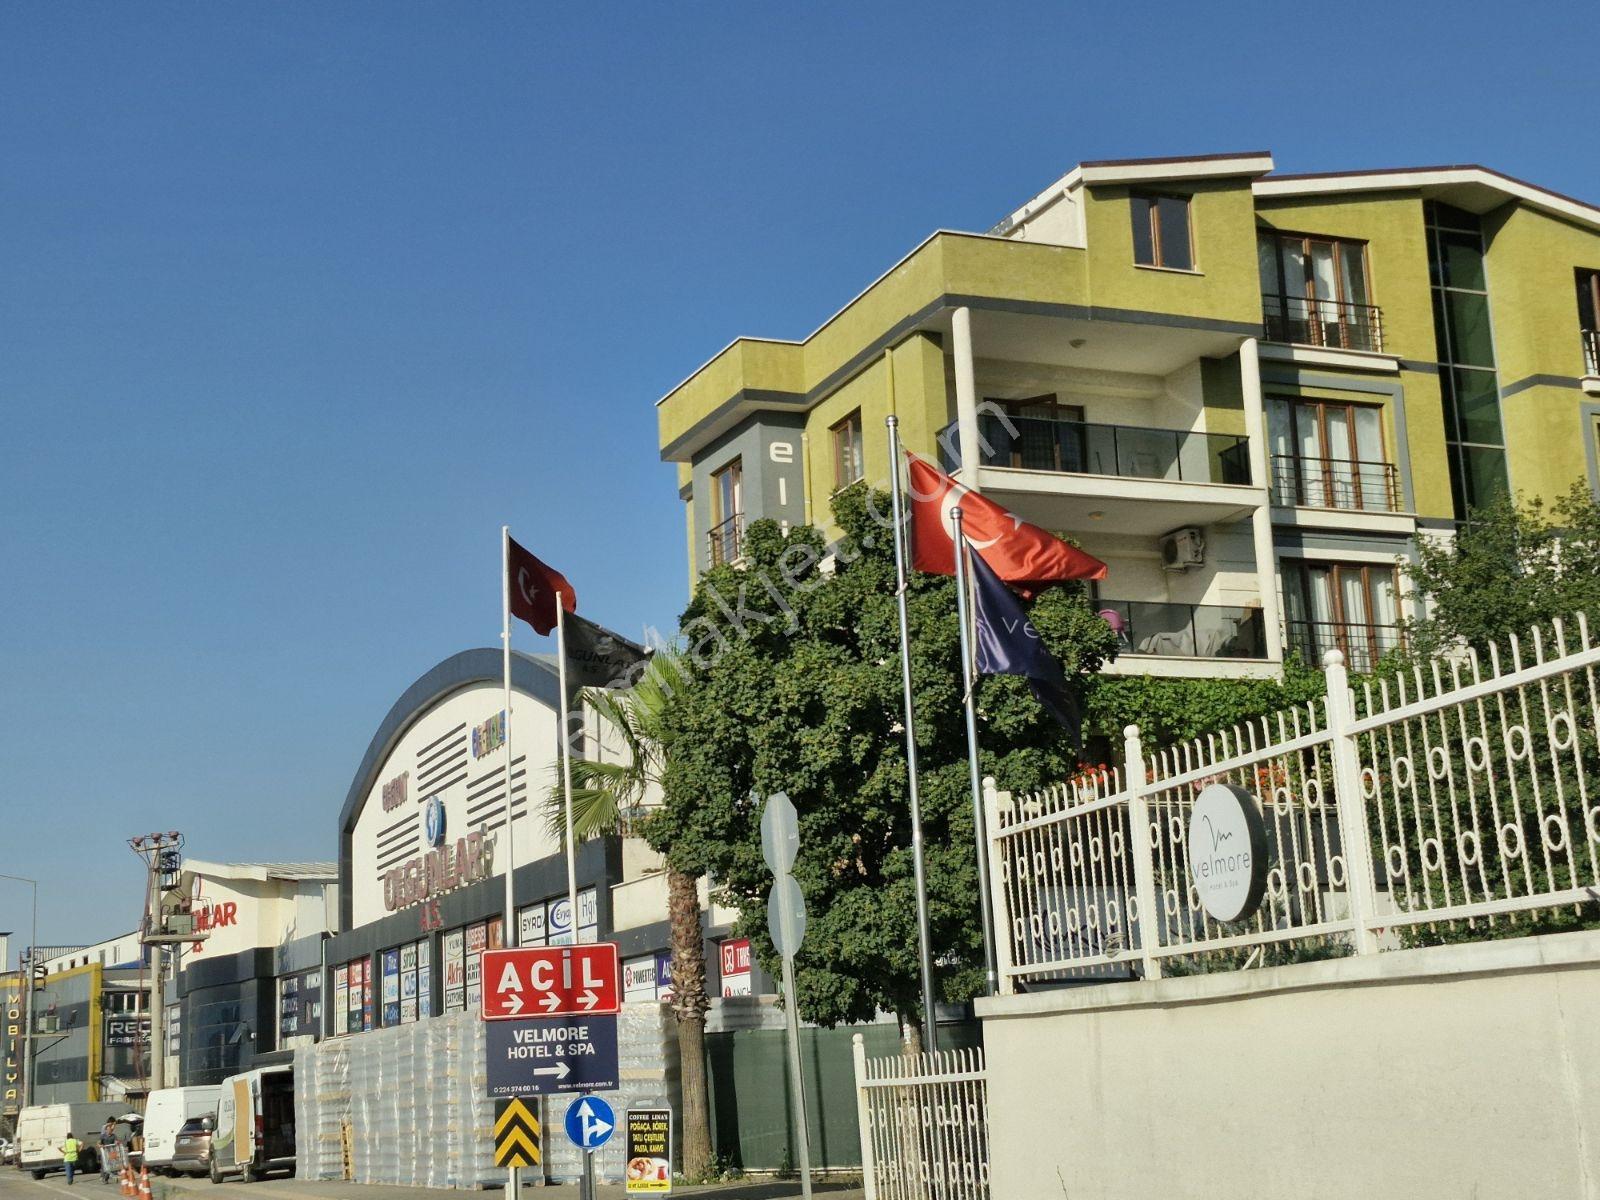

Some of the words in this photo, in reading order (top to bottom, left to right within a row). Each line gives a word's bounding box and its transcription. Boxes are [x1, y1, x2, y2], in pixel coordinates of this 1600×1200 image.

[1192, 852, 1250, 878] velmore
[513, 1026, 588, 1043] VELMORE
[508, 1045, 552, 1059] HOTEL
[555, 1044, 565, 1056] &
[568, 1042, 595, 1055] SPA
